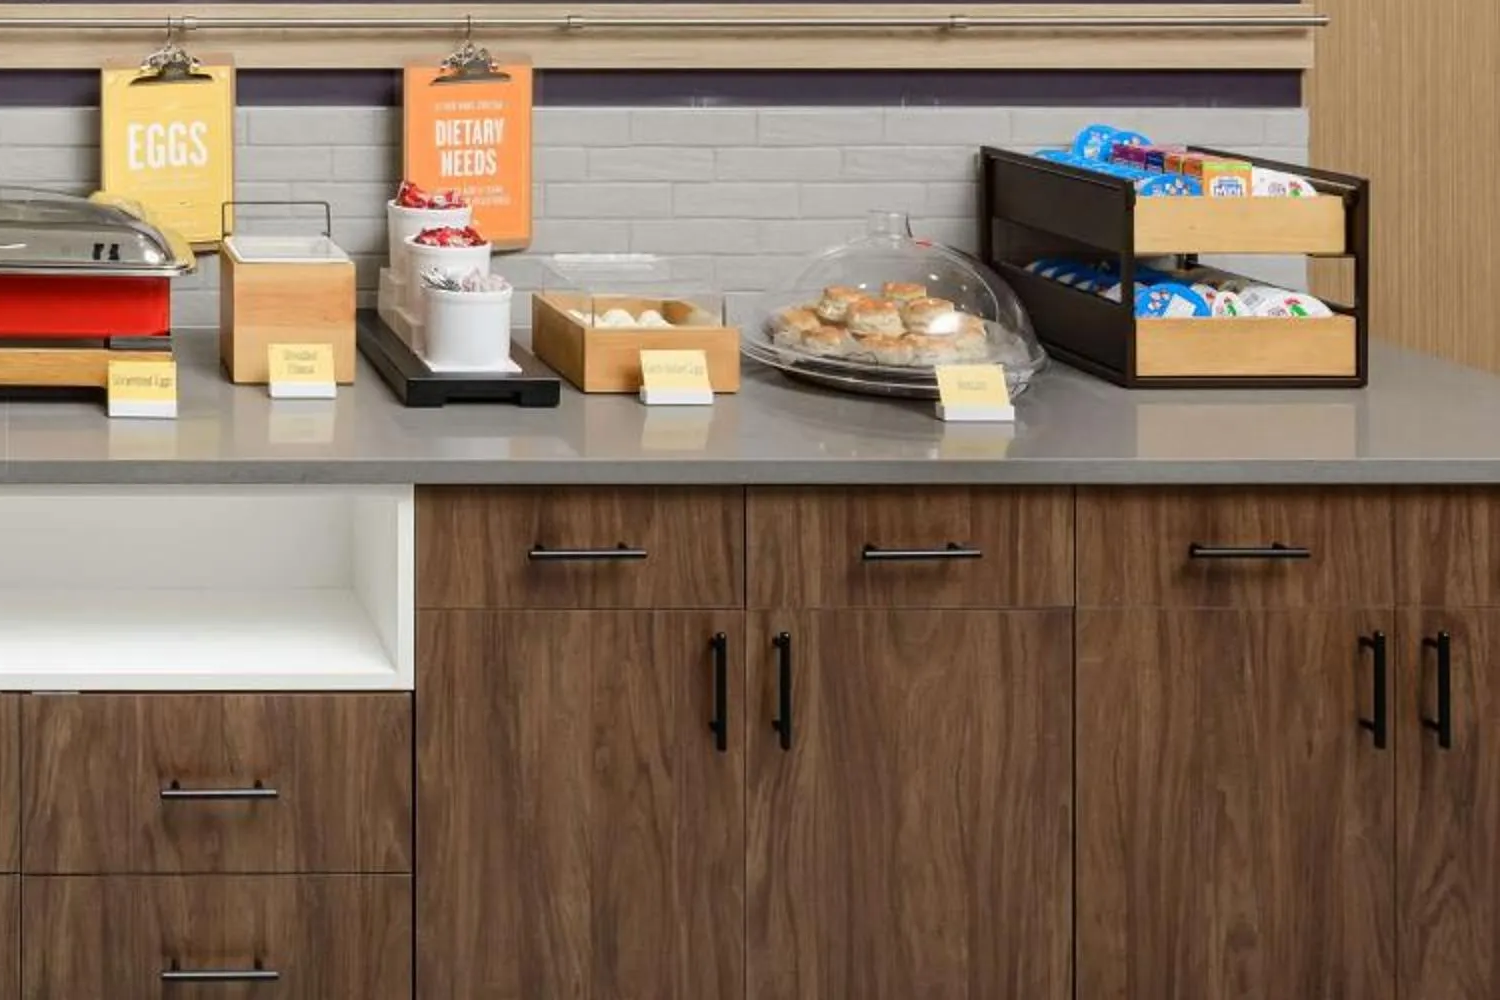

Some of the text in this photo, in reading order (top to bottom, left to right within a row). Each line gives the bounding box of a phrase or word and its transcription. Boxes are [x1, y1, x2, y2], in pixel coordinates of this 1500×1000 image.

[127, 120, 208, 170] EGGS
[435, 118, 506, 147] DIETARY
[441, 148, 498, 177] NEEDS
